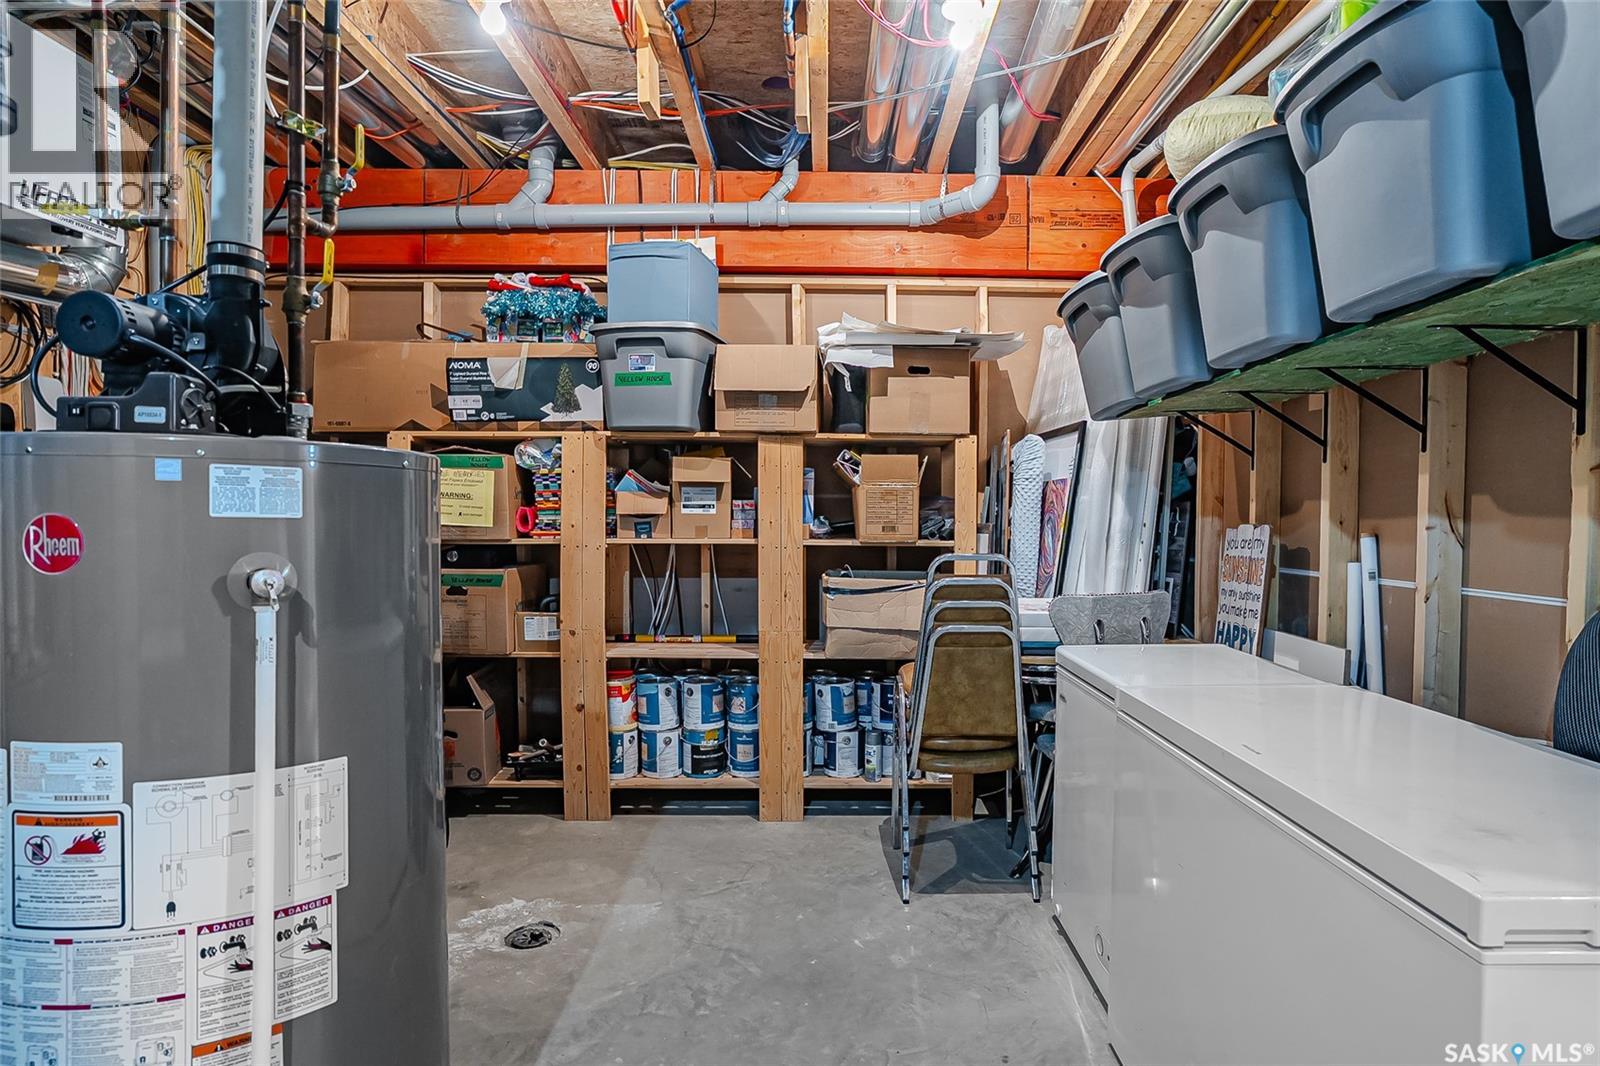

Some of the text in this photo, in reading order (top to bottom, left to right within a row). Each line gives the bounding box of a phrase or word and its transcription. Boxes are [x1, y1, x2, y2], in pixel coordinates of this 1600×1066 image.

[30, 514, 80, 564] Rheem
[1226, 538, 1266, 553] you are my
[1222, 554, 1265, 586] SUNSHINE
[1221, 587, 1261, 602] my only sunshine
[1219, 603, 1259, 620] you make me
[1216, 620, 1257, 655] HAPPY
[288, 897, 329, 916] DANGER
[213, 917, 255, 932] DANGE
